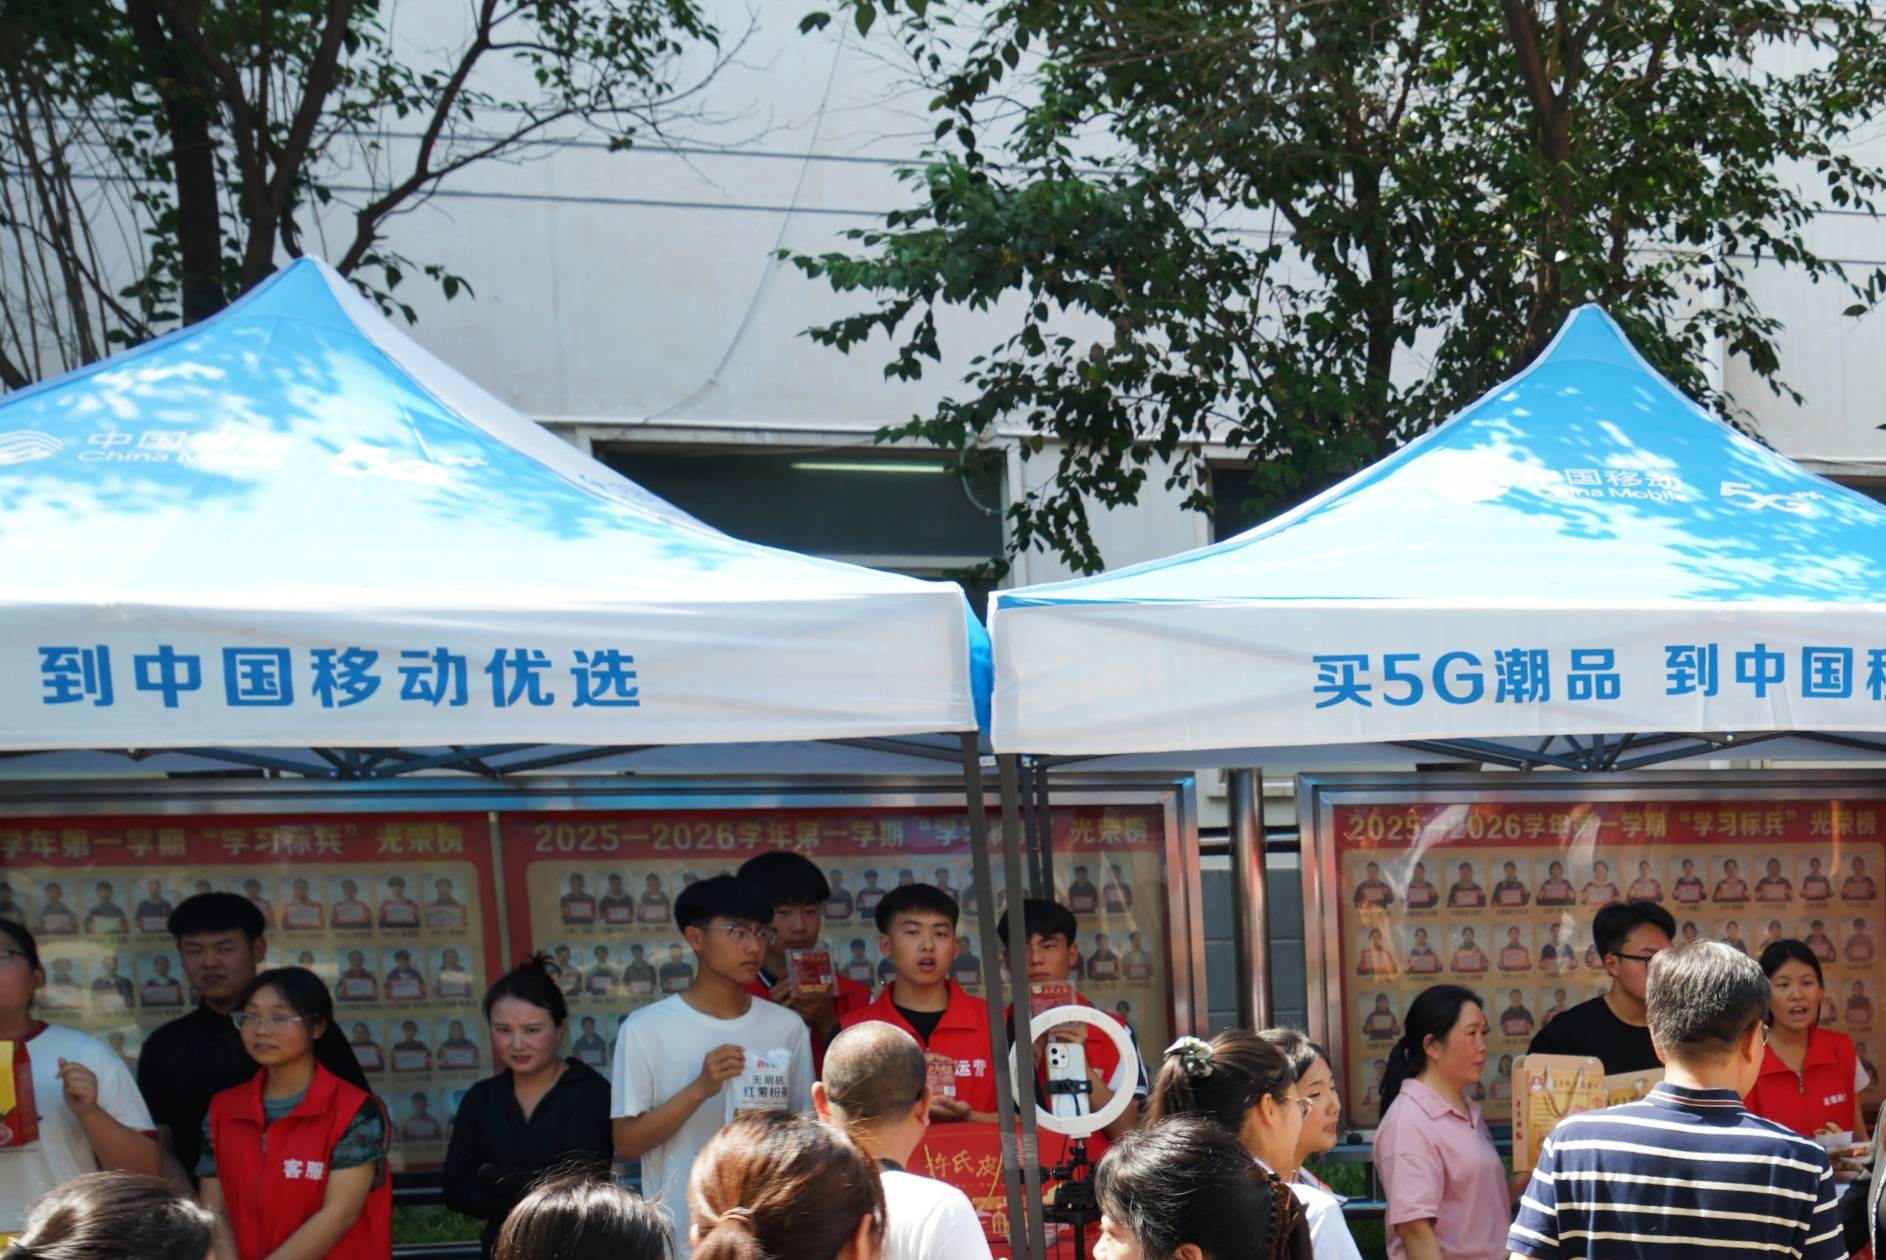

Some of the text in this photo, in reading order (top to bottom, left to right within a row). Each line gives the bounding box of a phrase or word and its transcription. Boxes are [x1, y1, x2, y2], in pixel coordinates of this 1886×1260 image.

[37, 643, 641, 708] 到中国移动优选
[1311, 647, 1622, 709] 买5G潮品
[283, 1158, 325, 1181] 客服
